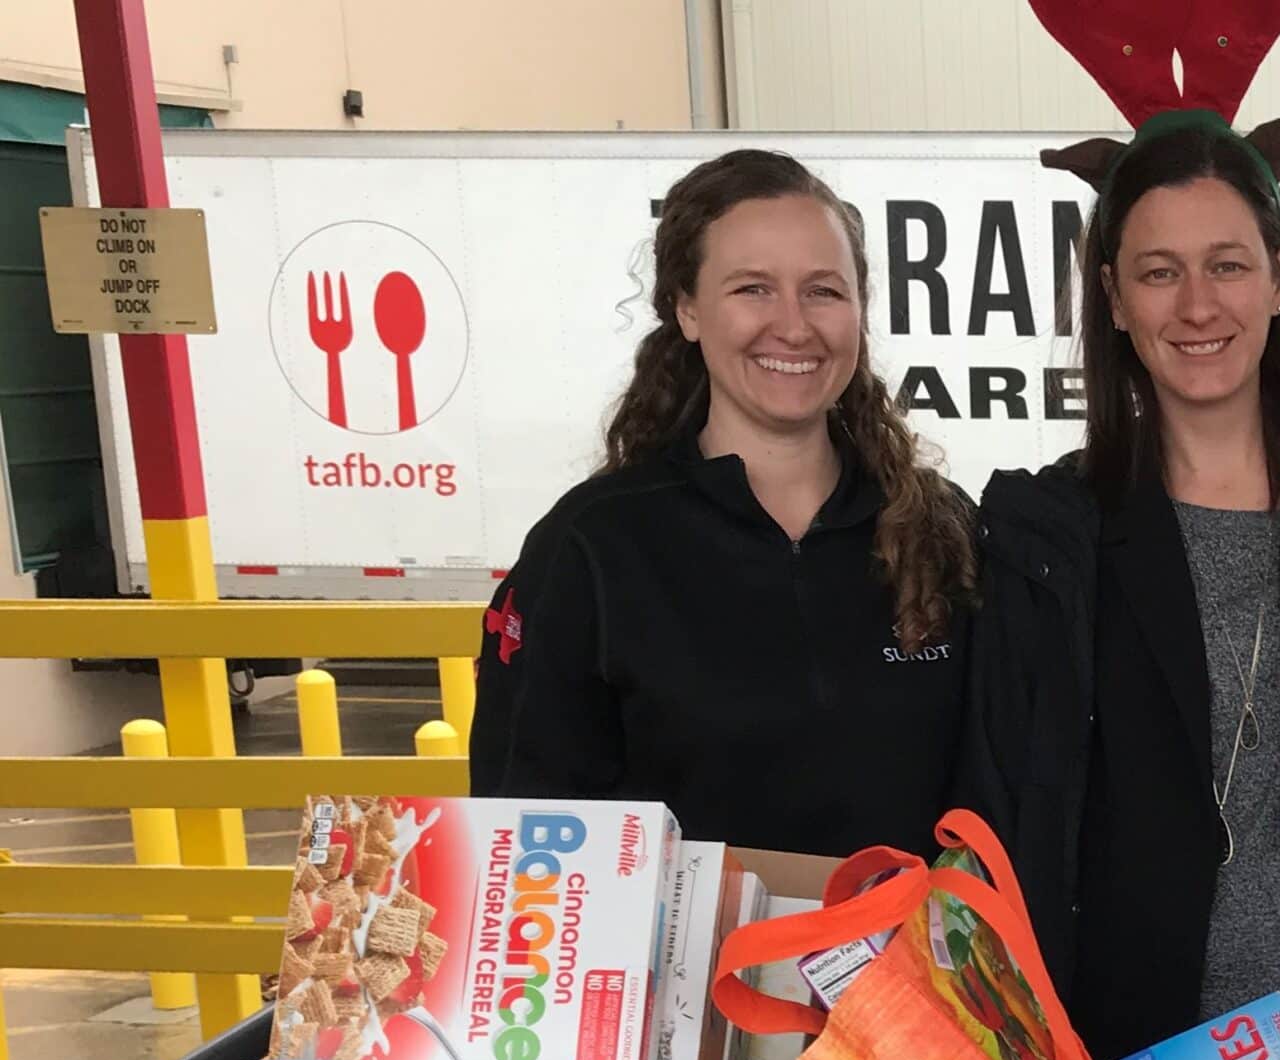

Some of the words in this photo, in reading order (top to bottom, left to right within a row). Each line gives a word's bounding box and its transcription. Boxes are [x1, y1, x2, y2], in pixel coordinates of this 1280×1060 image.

[101, 219, 118, 233] DO
[121, 219, 147, 233] NOT
[96, 239, 134, 253] CLIMB
[137, 240, 155, 253] ON
[119, 259, 137, 273] OR
[100, 280, 133, 294] JUMP
[136, 280, 160, 293] OFF
[115, 299, 151, 313] DOCK
[897, 366, 1088, 420] ARE
[304, 452, 457, 496] tafb.org
[616, 813, 641, 877] Millville
[479, 829, 514, 952] MULTIGRAIN
[554, 872, 590, 1005] cinnamon
[807, 953, 841, 978] Nutrition
[839, 940, 862, 957] Facts
[587, 974, 604, 990] NO
[605, 974, 623, 991] NO
[467, 959, 498, 1043] CEREAL
